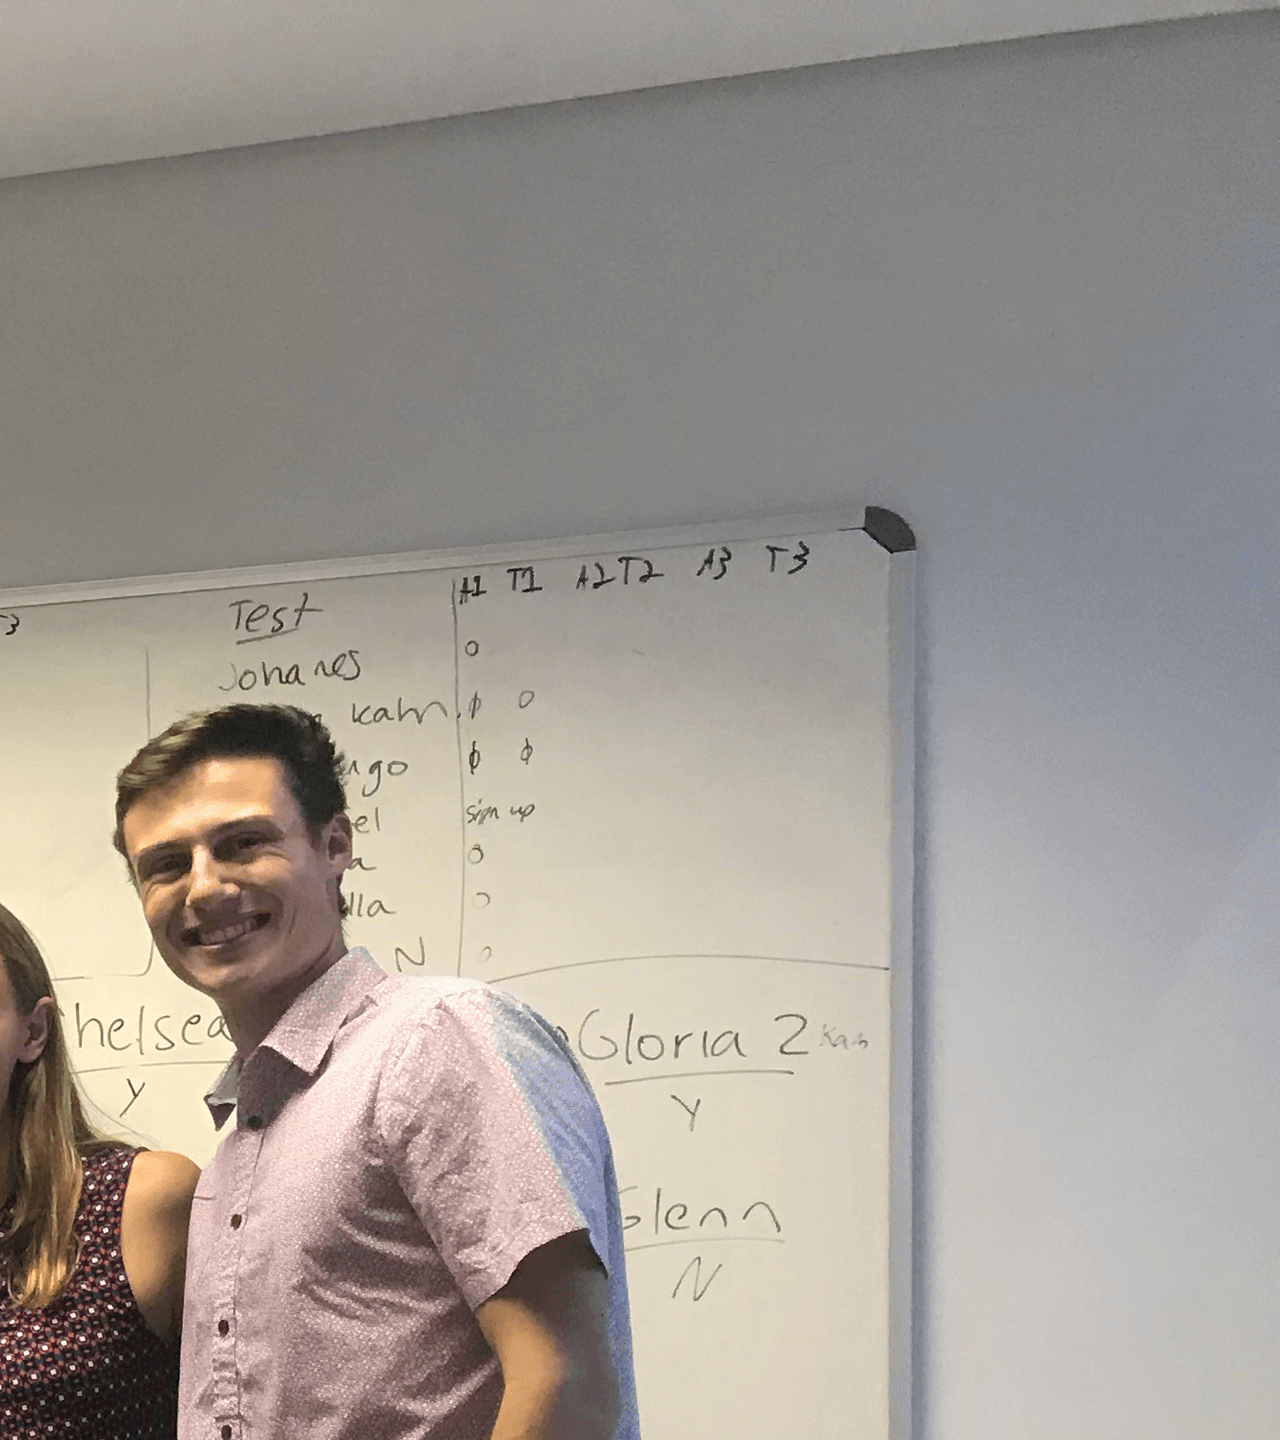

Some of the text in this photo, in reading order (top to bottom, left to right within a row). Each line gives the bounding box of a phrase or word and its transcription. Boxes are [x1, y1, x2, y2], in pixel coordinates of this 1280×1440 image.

[765, 540, 810, 575] T3
[228, 591, 324, 634] Test
[74, 1001, 234, 1056] helsea
[578, 1008, 747, 1065] Gloria
[774, 1013, 810, 1056] 2
[671, 1255, 723, 1302] N
